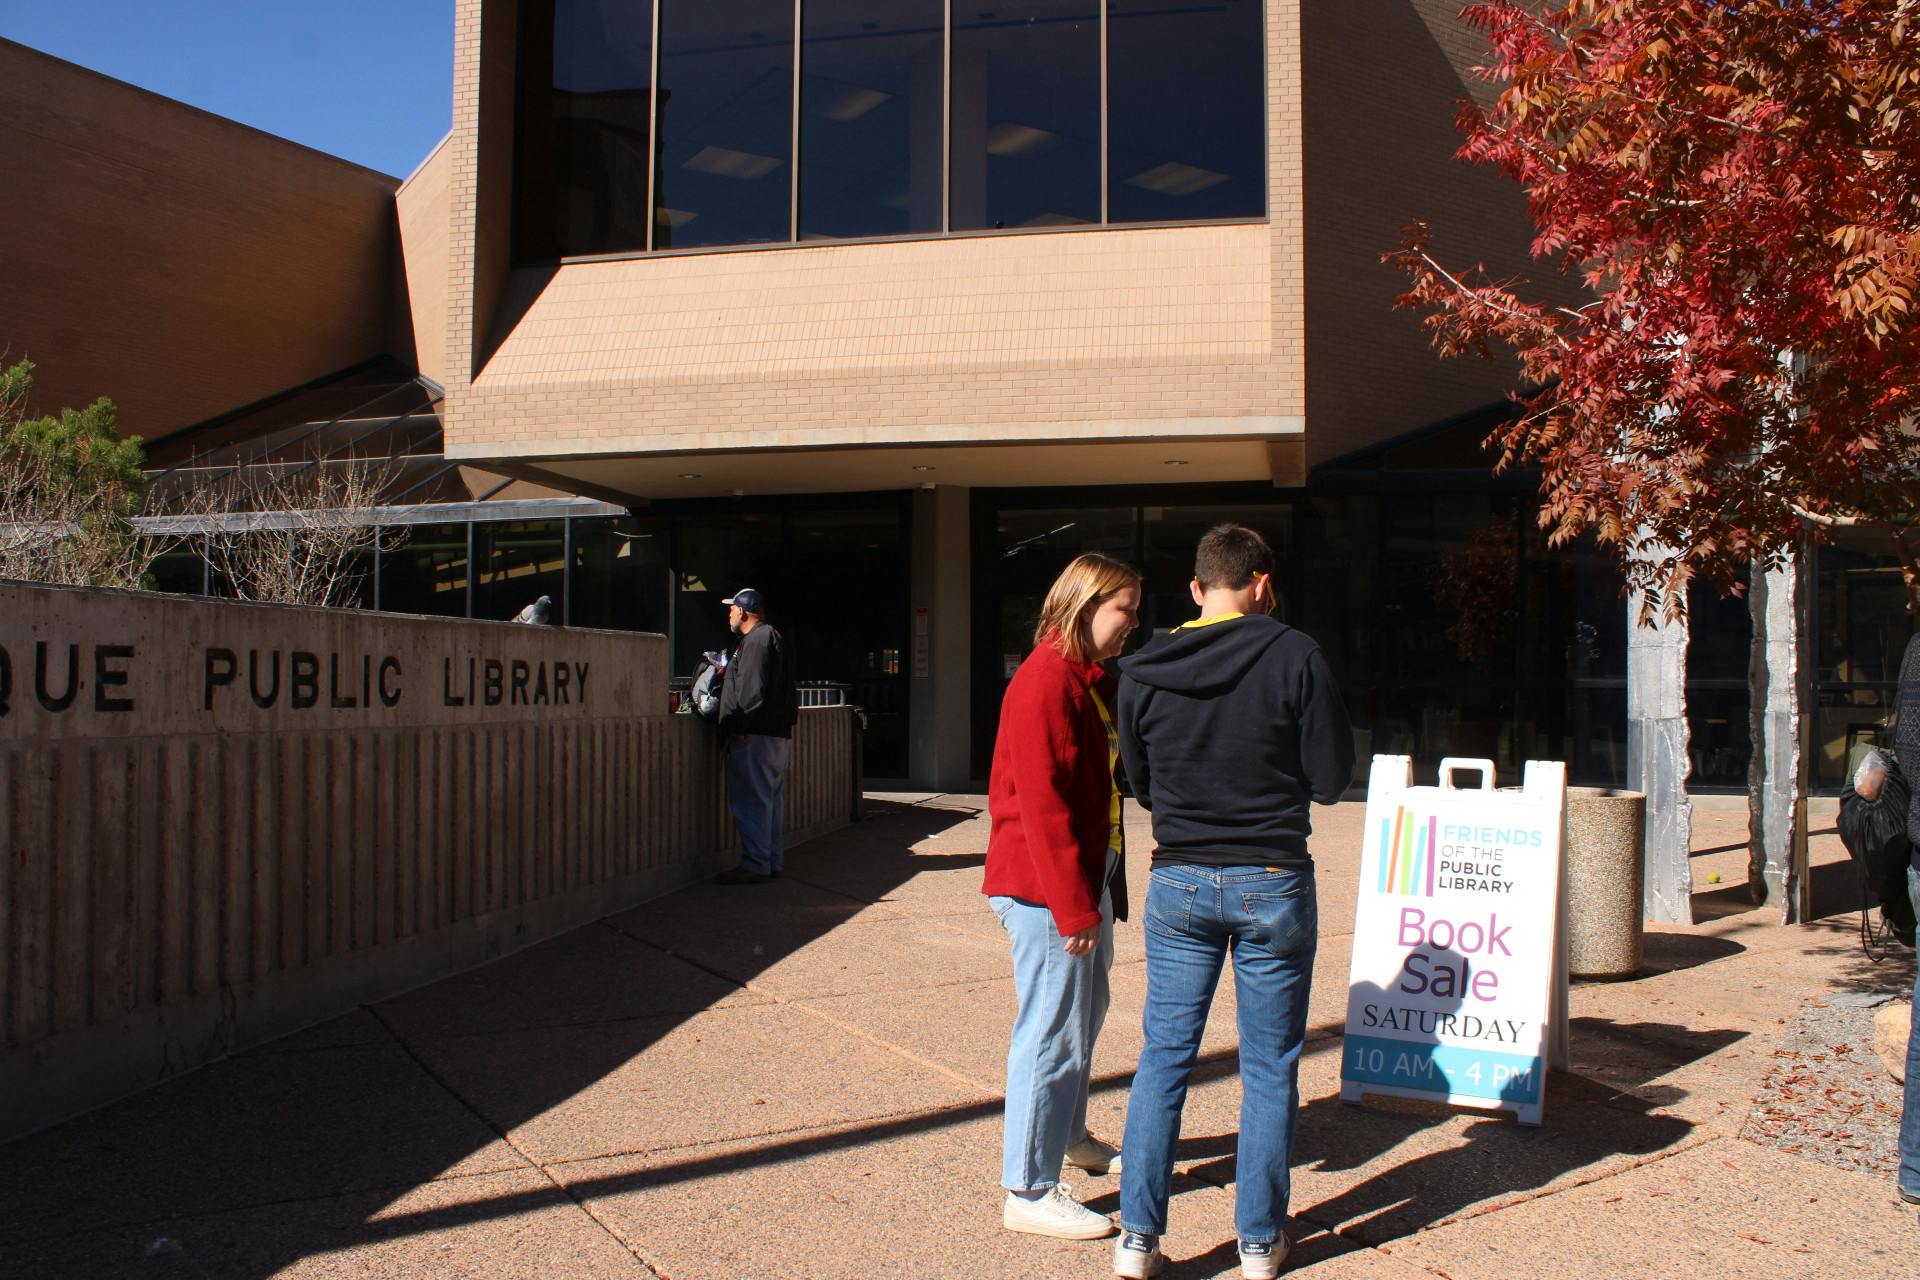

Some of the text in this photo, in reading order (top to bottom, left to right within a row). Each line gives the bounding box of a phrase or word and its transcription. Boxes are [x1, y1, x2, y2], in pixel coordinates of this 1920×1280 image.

[0, 641, 590, 717] UE PUBLIC LIBRARY
[1441, 844, 1504, 861] OF THE
[1443, 825, 1543, 847] FRIENDS
[1438, 876, 1514, 893] LIBRARY
[1440, 861, 1502, 876] PUBLIC
[1398, 907, 1512, 956] Book
[1400, 953, 1499, 1001] Sale
[1362, 1003, 1527, 1043] SATURDAY
[1353, 1048, 1384, 1073] 10
[1392, 1053, 1434, 1080] AM
[1465, 1061, 1482, 1086] 4
[1492, 1063, 1533, 1093] PM
